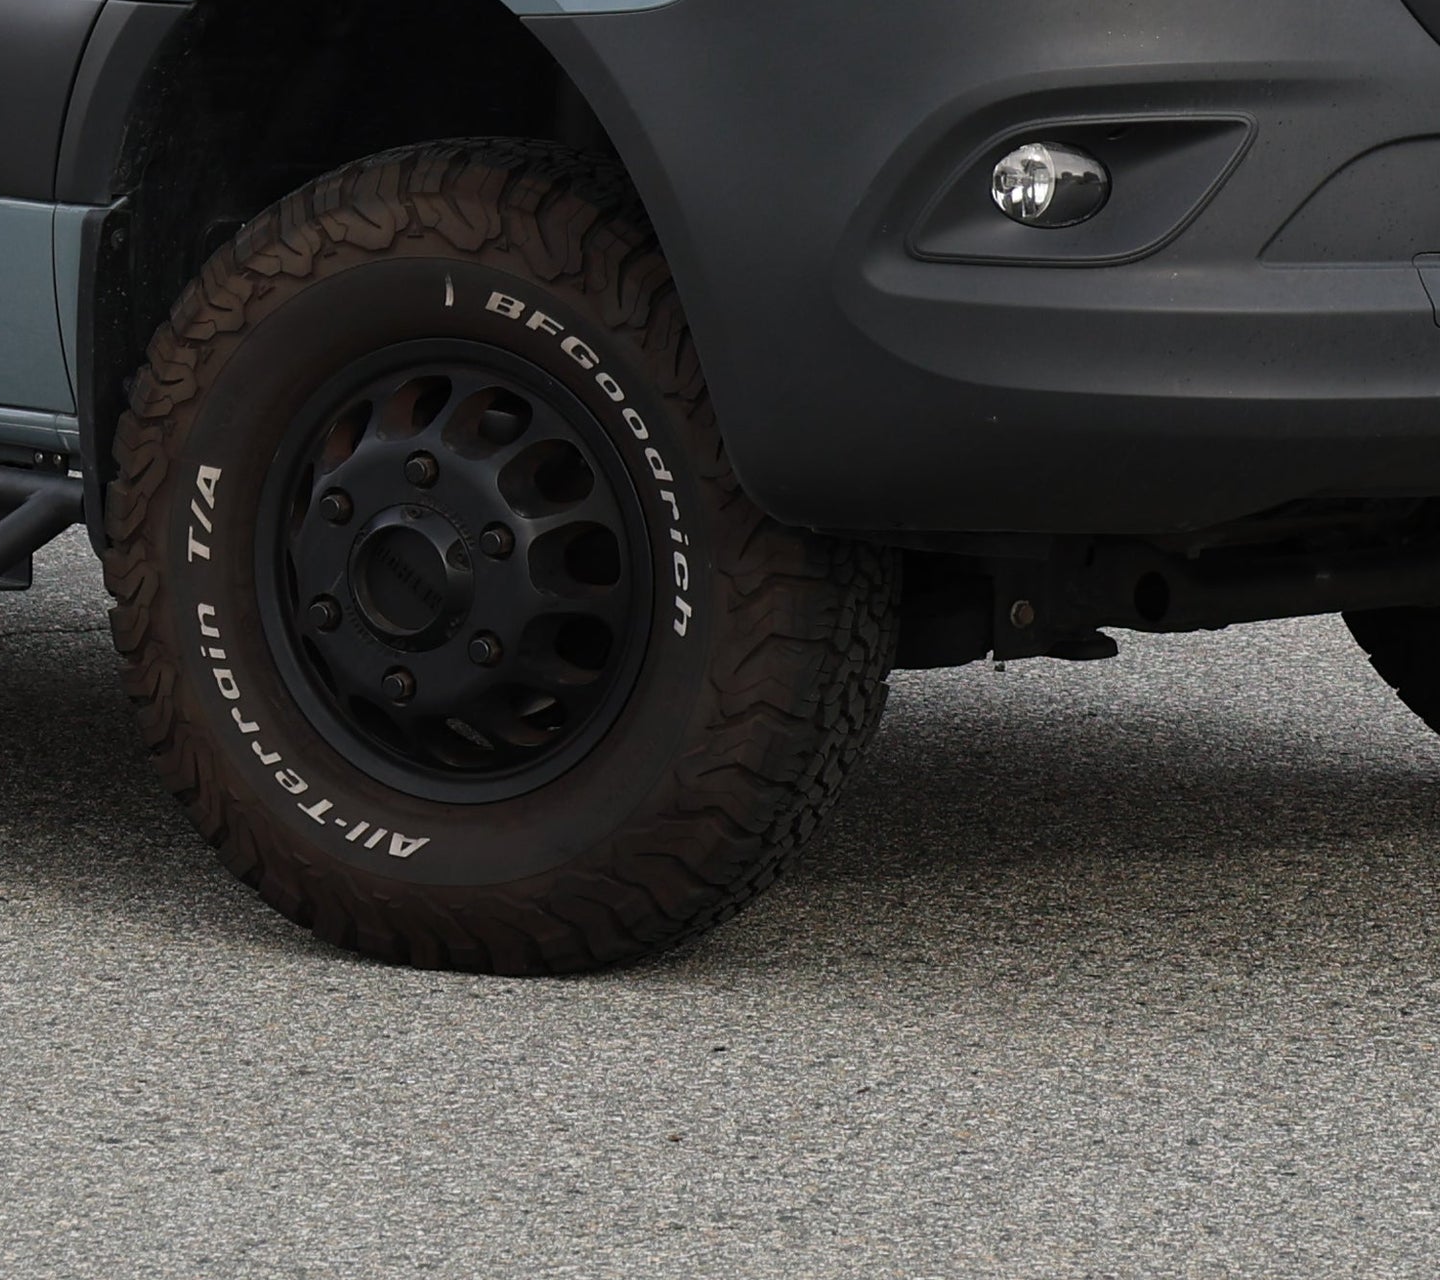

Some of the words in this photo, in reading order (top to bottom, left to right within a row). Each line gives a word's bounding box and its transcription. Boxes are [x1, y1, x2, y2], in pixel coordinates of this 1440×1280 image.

[187, 464, 222, 562] T/A
[485, 291, 692, 638] BFGoodrich
[198, 601, 430, 859] All-Terrain
